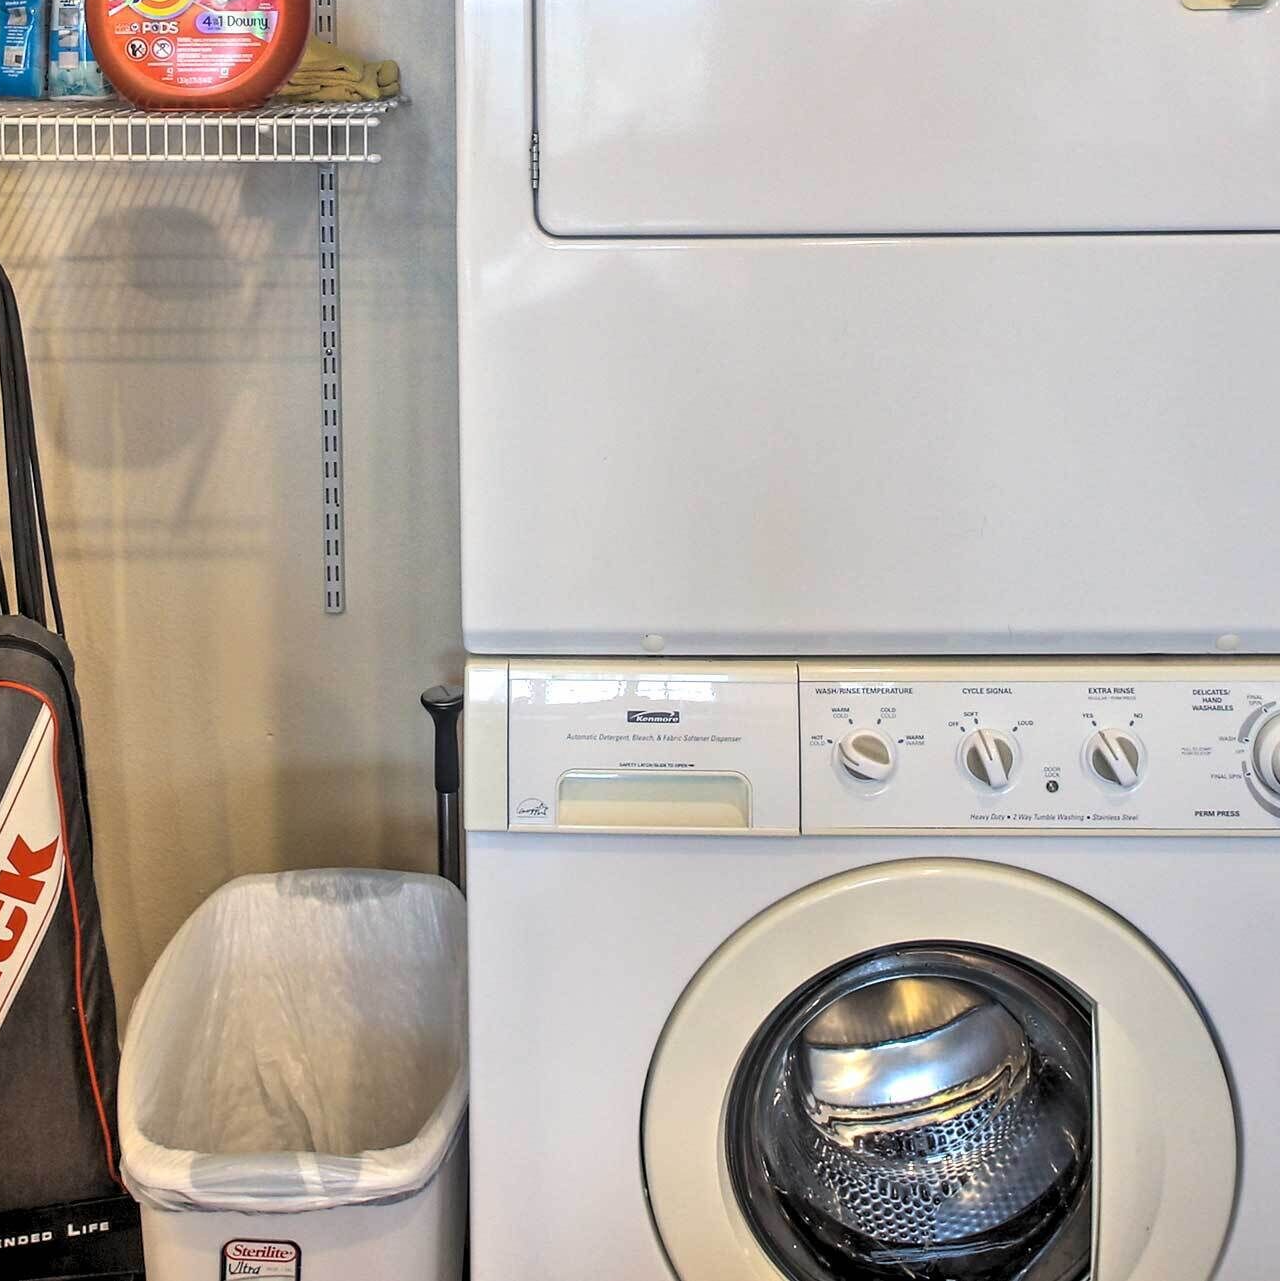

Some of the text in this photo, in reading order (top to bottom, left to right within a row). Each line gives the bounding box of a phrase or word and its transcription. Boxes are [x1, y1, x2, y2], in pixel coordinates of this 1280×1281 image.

[227, 15, 269, 30] Downy
[142, 21, 180, 35] PODS
[815, 687, 914, 695] WASH/RINSE TEMPERATURE
[962, 687, 1013, 695] CYCLE SIGNAL
[1192, 704, 1234, 712] WASHABLES
[635, 715, 679, 723] Kenmore
[566, 733, 598, 741] Automatic
[683, 734, 710, 742] Softener
[711, 734, 742, 744] Dispenser
[970, 813, 1006, 821] Heavy Duty
[1019, 813, 1032, 821] Way
[1057, 813, 1084, 821] Washing
[232, 1244, 289, 1259] Sterilite
[228, 1262, 261, 1275] Ultra
